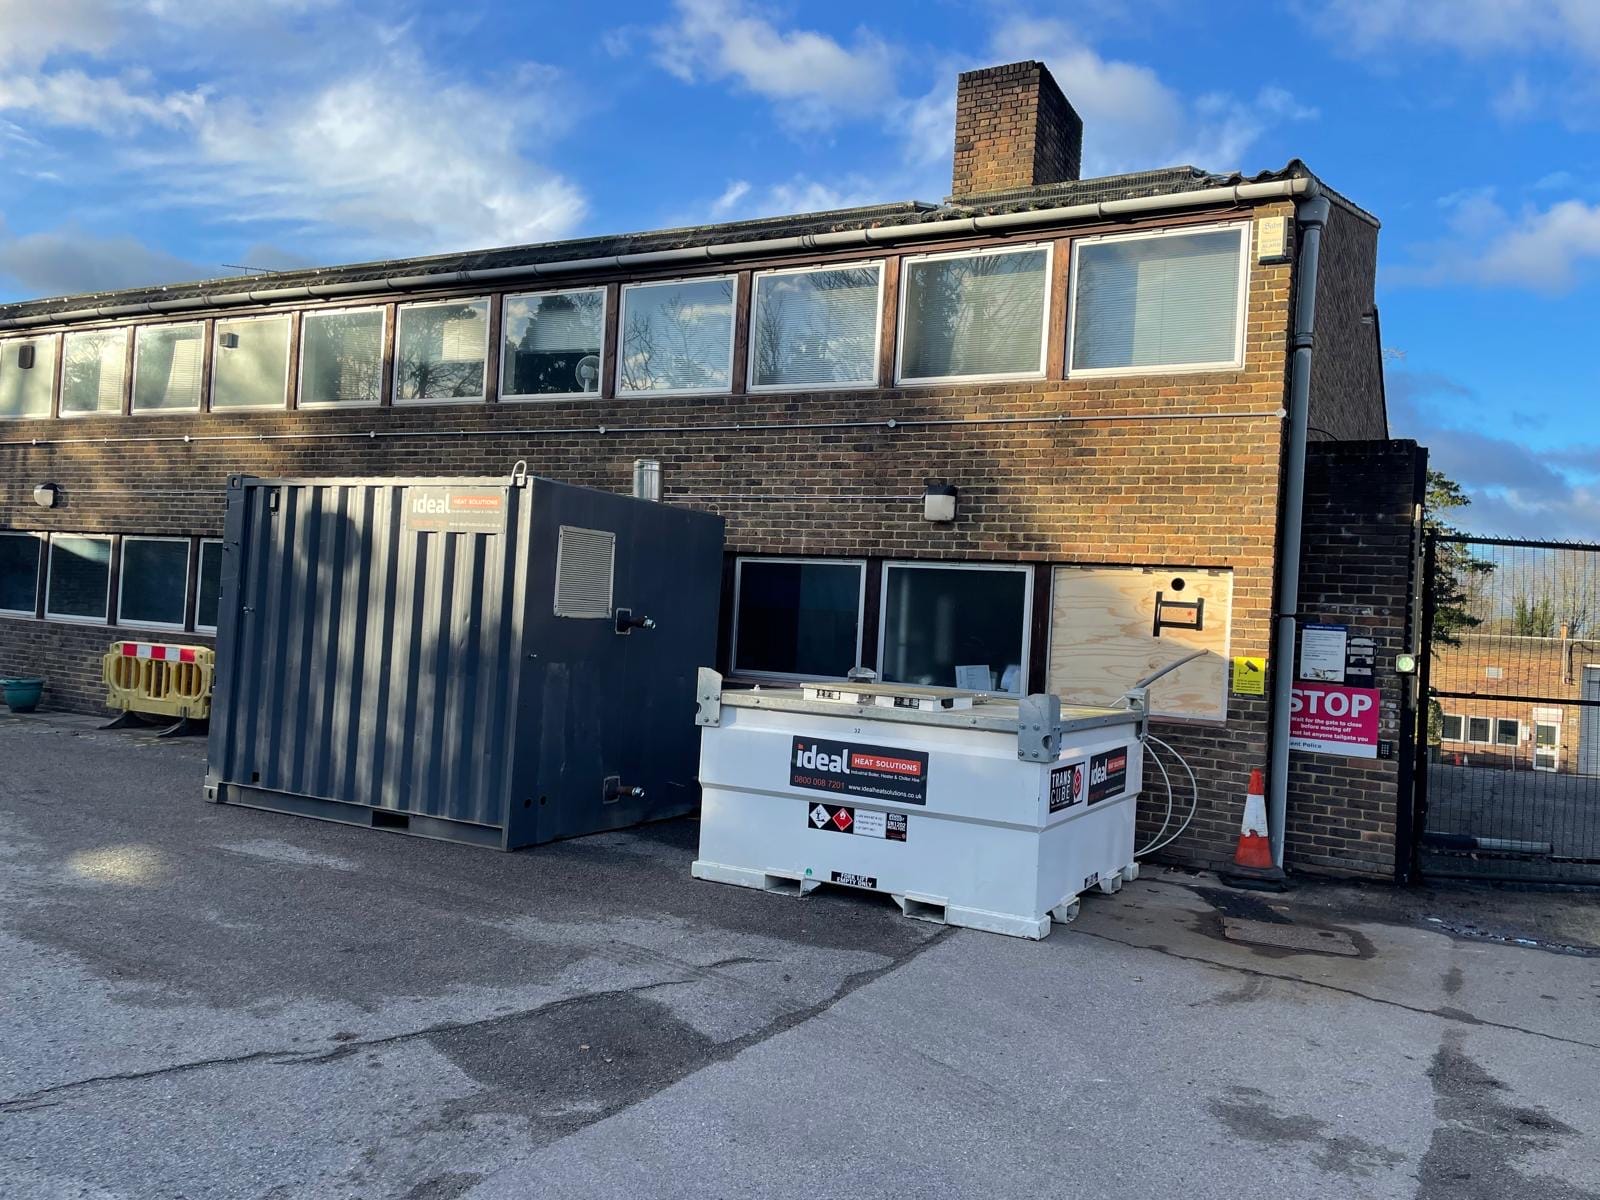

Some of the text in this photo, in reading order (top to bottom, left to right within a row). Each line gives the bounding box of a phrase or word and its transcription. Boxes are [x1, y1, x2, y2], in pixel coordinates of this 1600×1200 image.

[411, 492, 451, 514] ideal
[1291, 688, 1372, 718] STOP
[1334, 733, 1356, 741] tailgate
[796, 743, 850, 774] ideal
[854, 758, 917, 772] HEAT SOLUTIONS
[1052, 770, 1071, 789] TRANS
[1091, 758, 1108, 786] ideal
[794, 775, 845, 789] 0800 008 7201
[848, 785, 922, 799] www.idealheatsolutions.co.uk
[1050, 785, 1070, 805] CUBE
[836, 876, 873, 888] EMPTY ONLY
